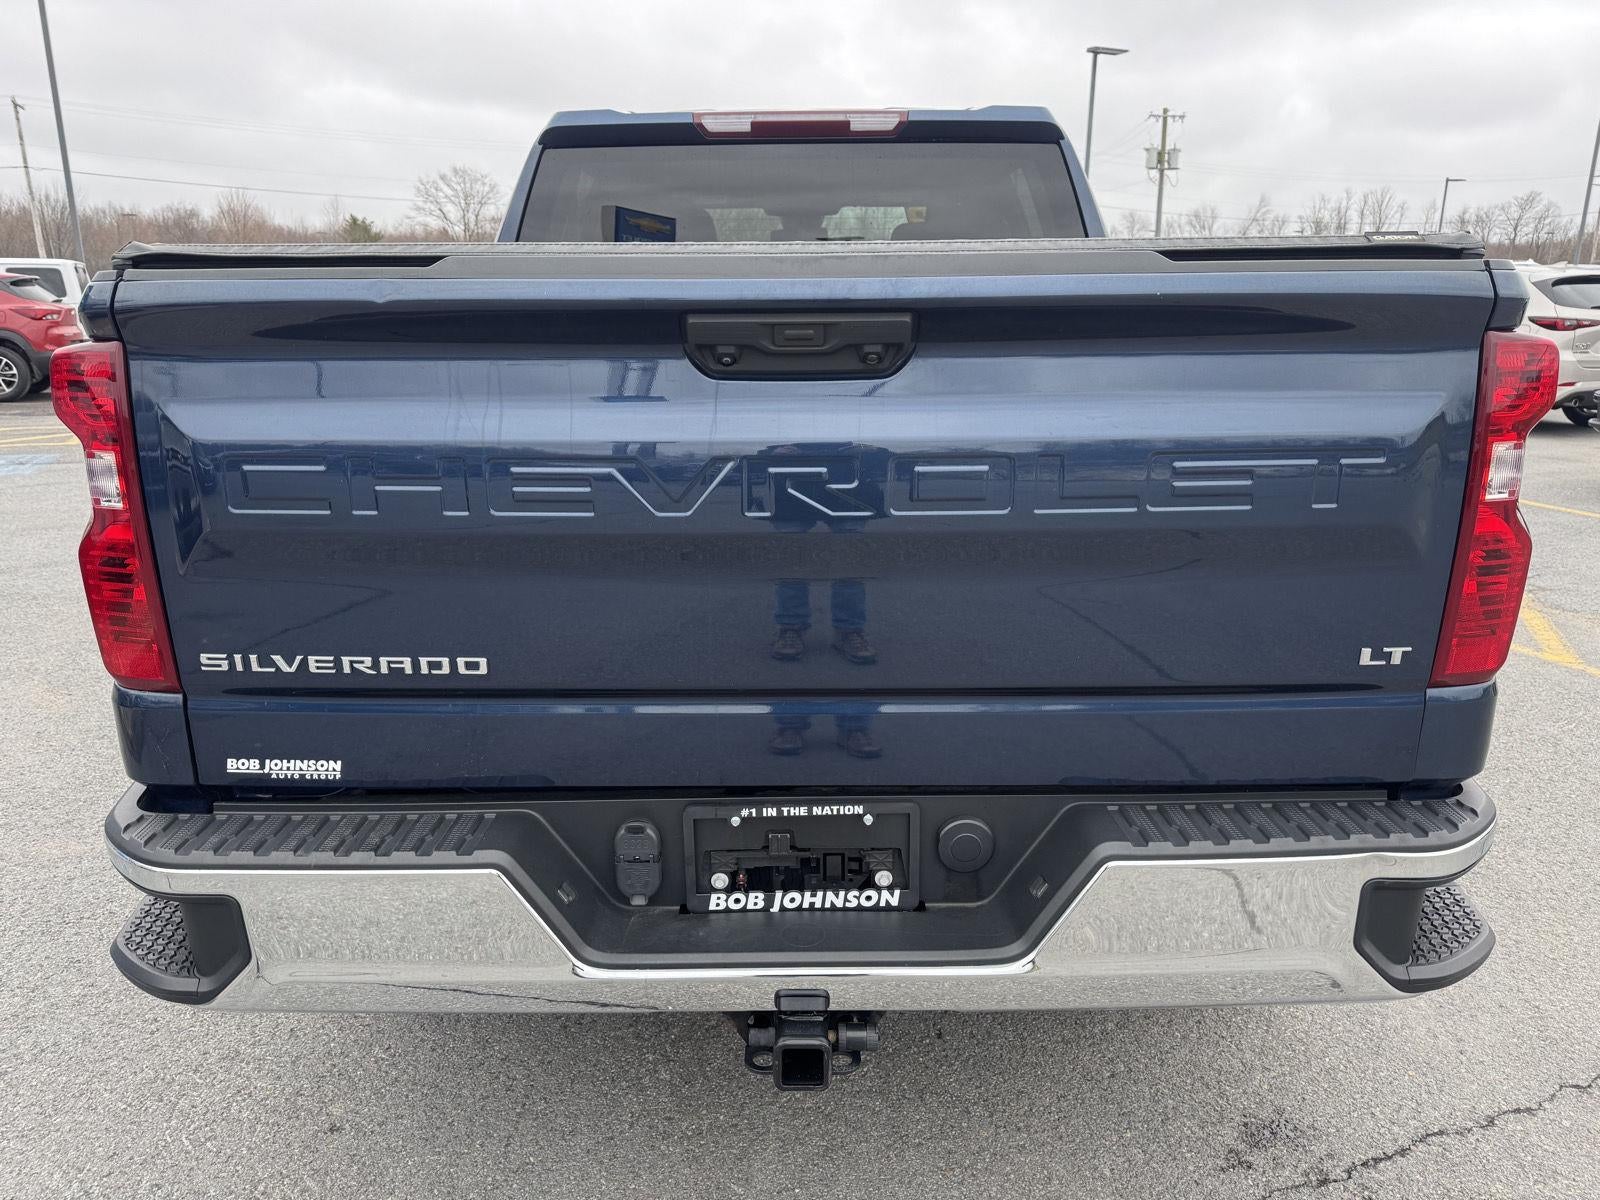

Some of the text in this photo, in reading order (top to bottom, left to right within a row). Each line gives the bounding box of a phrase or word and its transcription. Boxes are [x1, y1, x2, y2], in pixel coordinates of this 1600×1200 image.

[222, 448, 1388, 517] CHEVROLET
[200, 653, 488, 675] SILVERADO
[1359, 647, 1412, 665] LT
[226, 758, 342, 773] BOB JOHNSON
[740, 805, 864, 817] #1 IN THE NATION
[708, 889, 901, 913] BOB JOHNSON
